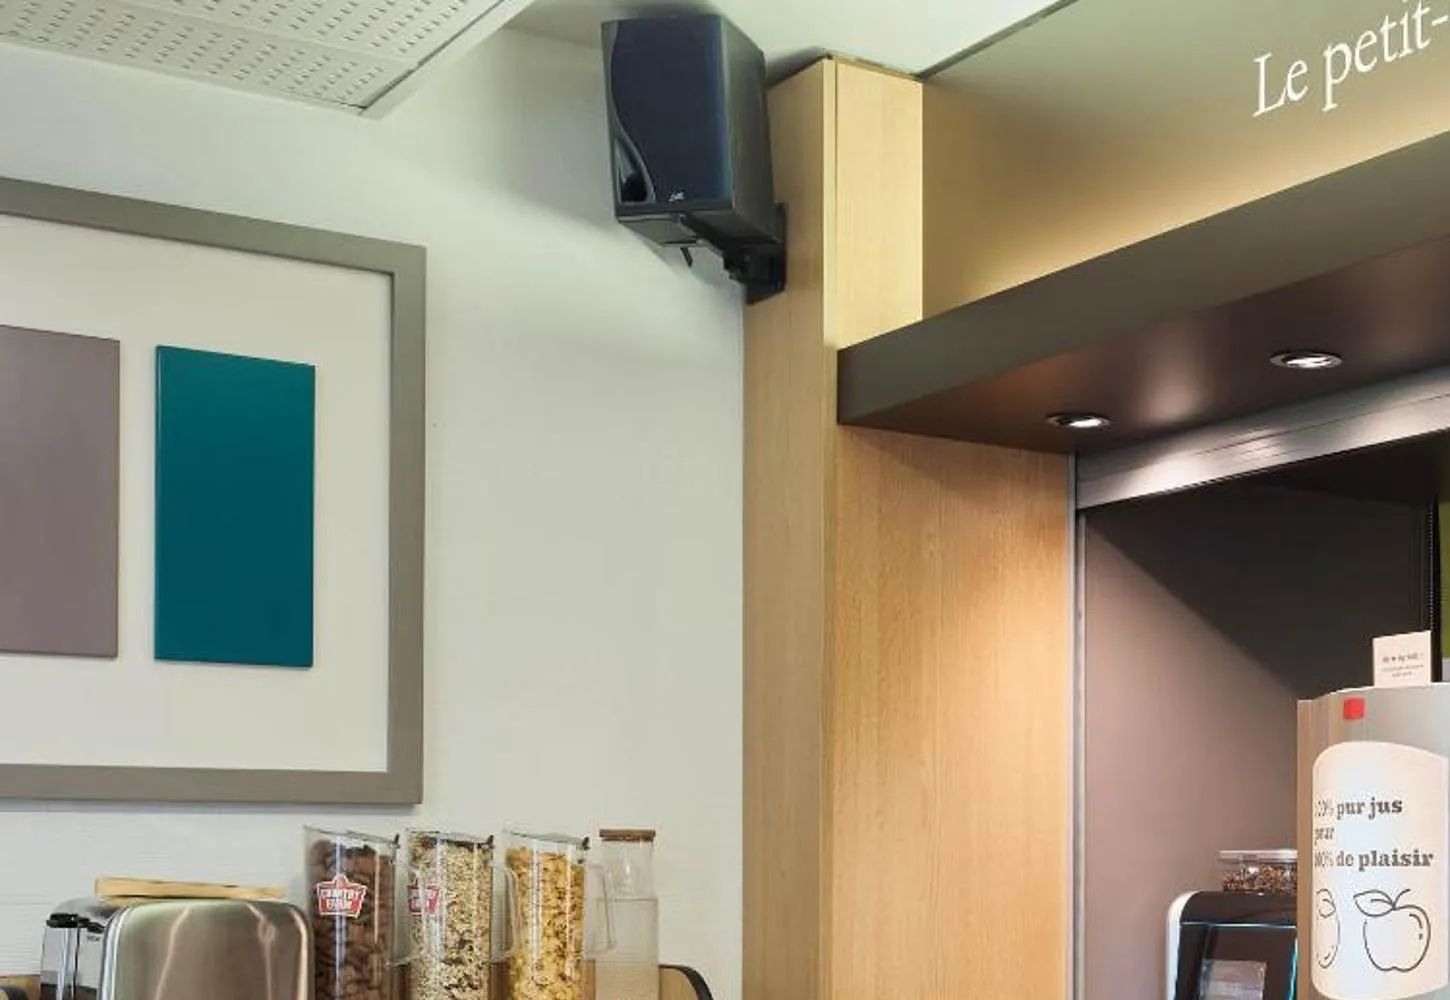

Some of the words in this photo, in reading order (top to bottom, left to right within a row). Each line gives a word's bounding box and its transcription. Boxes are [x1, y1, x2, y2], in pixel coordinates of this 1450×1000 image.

[1253, 52, 1309, 117] Le
[1336, 801, 1365, 820] pur
[1368, 796, 1403, 819] jus
[1336, 850, 1354, 867] de
[1358, 849, 1435, 872] plaisir
